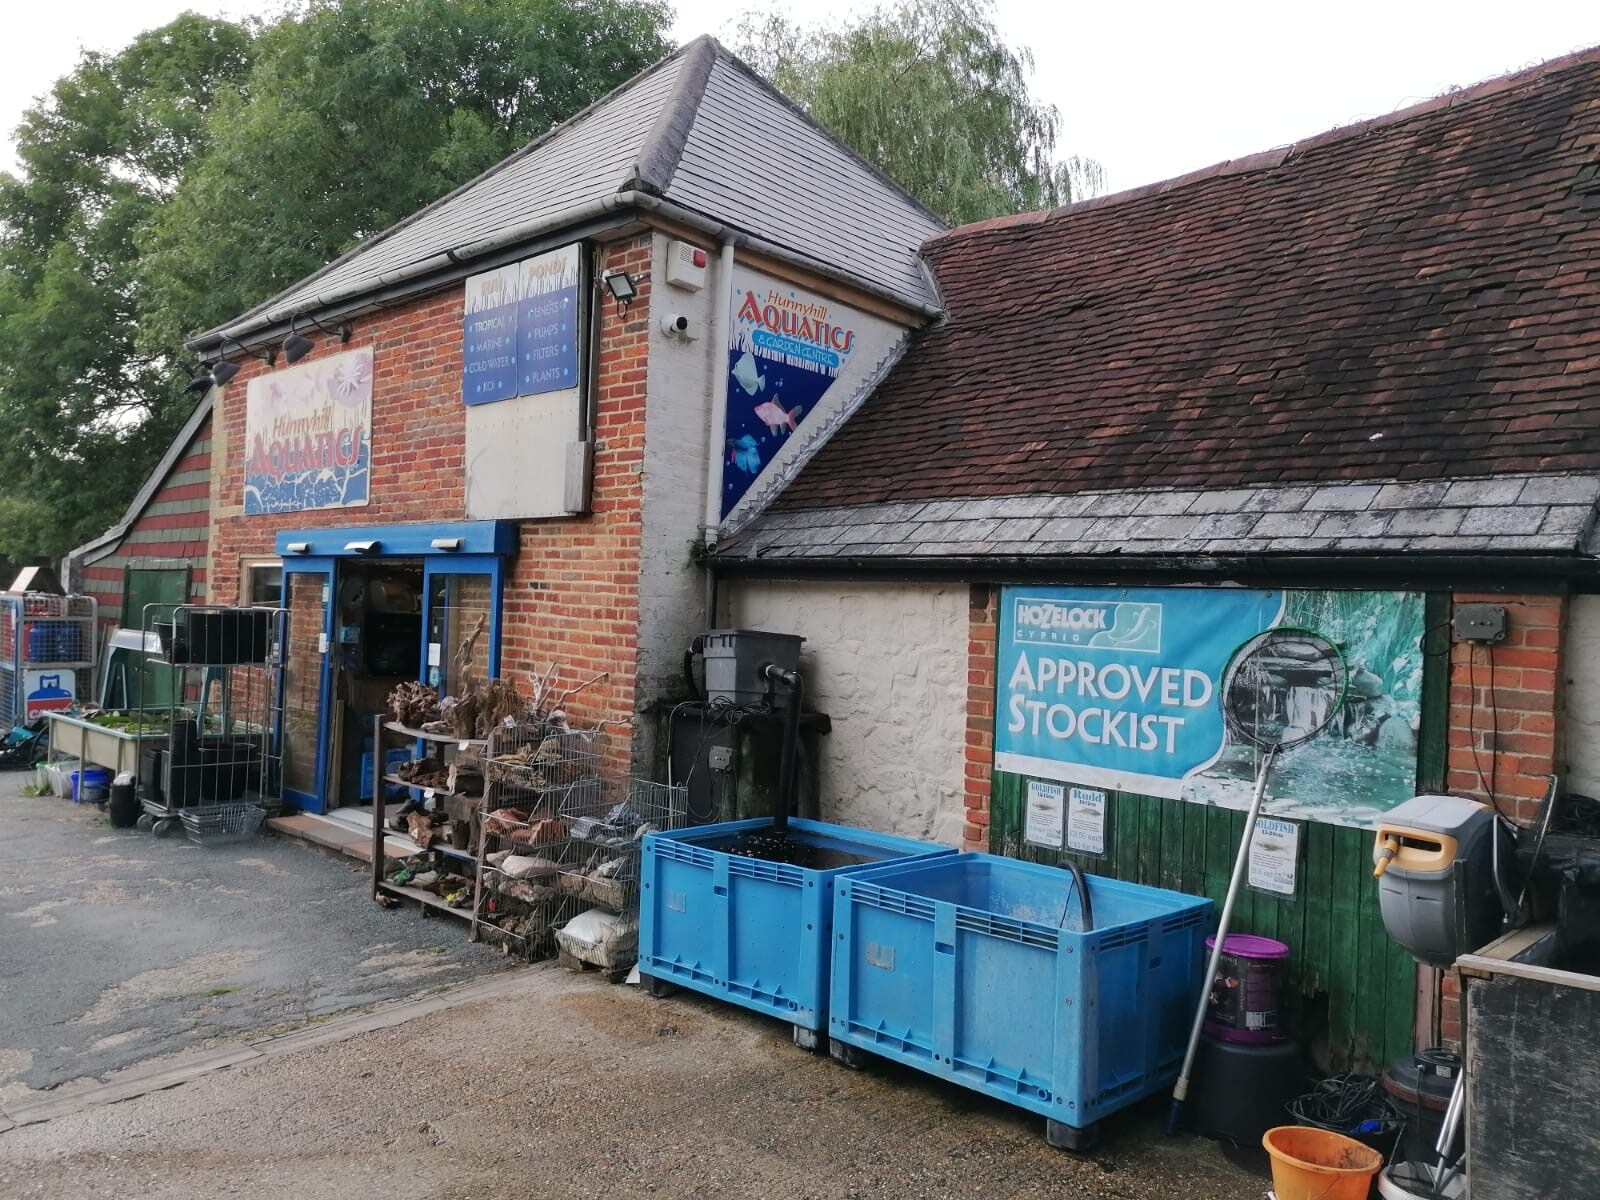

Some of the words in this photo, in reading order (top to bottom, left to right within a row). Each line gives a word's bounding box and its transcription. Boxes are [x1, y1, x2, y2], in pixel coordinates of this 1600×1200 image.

[768, 290, 827, 320] Hunnyhill
[475, 316, 505, 333] TROPICAL
[738, 290, 853, 350] AQUATICS
[534, 323, 559, 339] PUMPS
[476, 336, 503, 353] MARINE
[533, 345, 559, 361] FILTERS
[766, 336, 801, 354] GARDEN
[801, 347, 834, 366] CENTRE
[532, 367, 560, 384] PLANTS
[482, 380, 496, 393] KOI
[273, 405, 334, 438] Hunnyhill
[252, 423, 364, 479] AQUATICS
[1017, 603, 1106, 629] HOZELOCK
[1017, 629, 1080, 642] CYPRIO
[1008, 650, 1213, 707] APPROVED
[1007, 694, 1185, 754] STOCKIST
[1031, 783, 1061, 796] GOLDFISH
[1073, 789, 1102, 803] Rudd
[1256, 819, 1294, 834] OLDFISH
